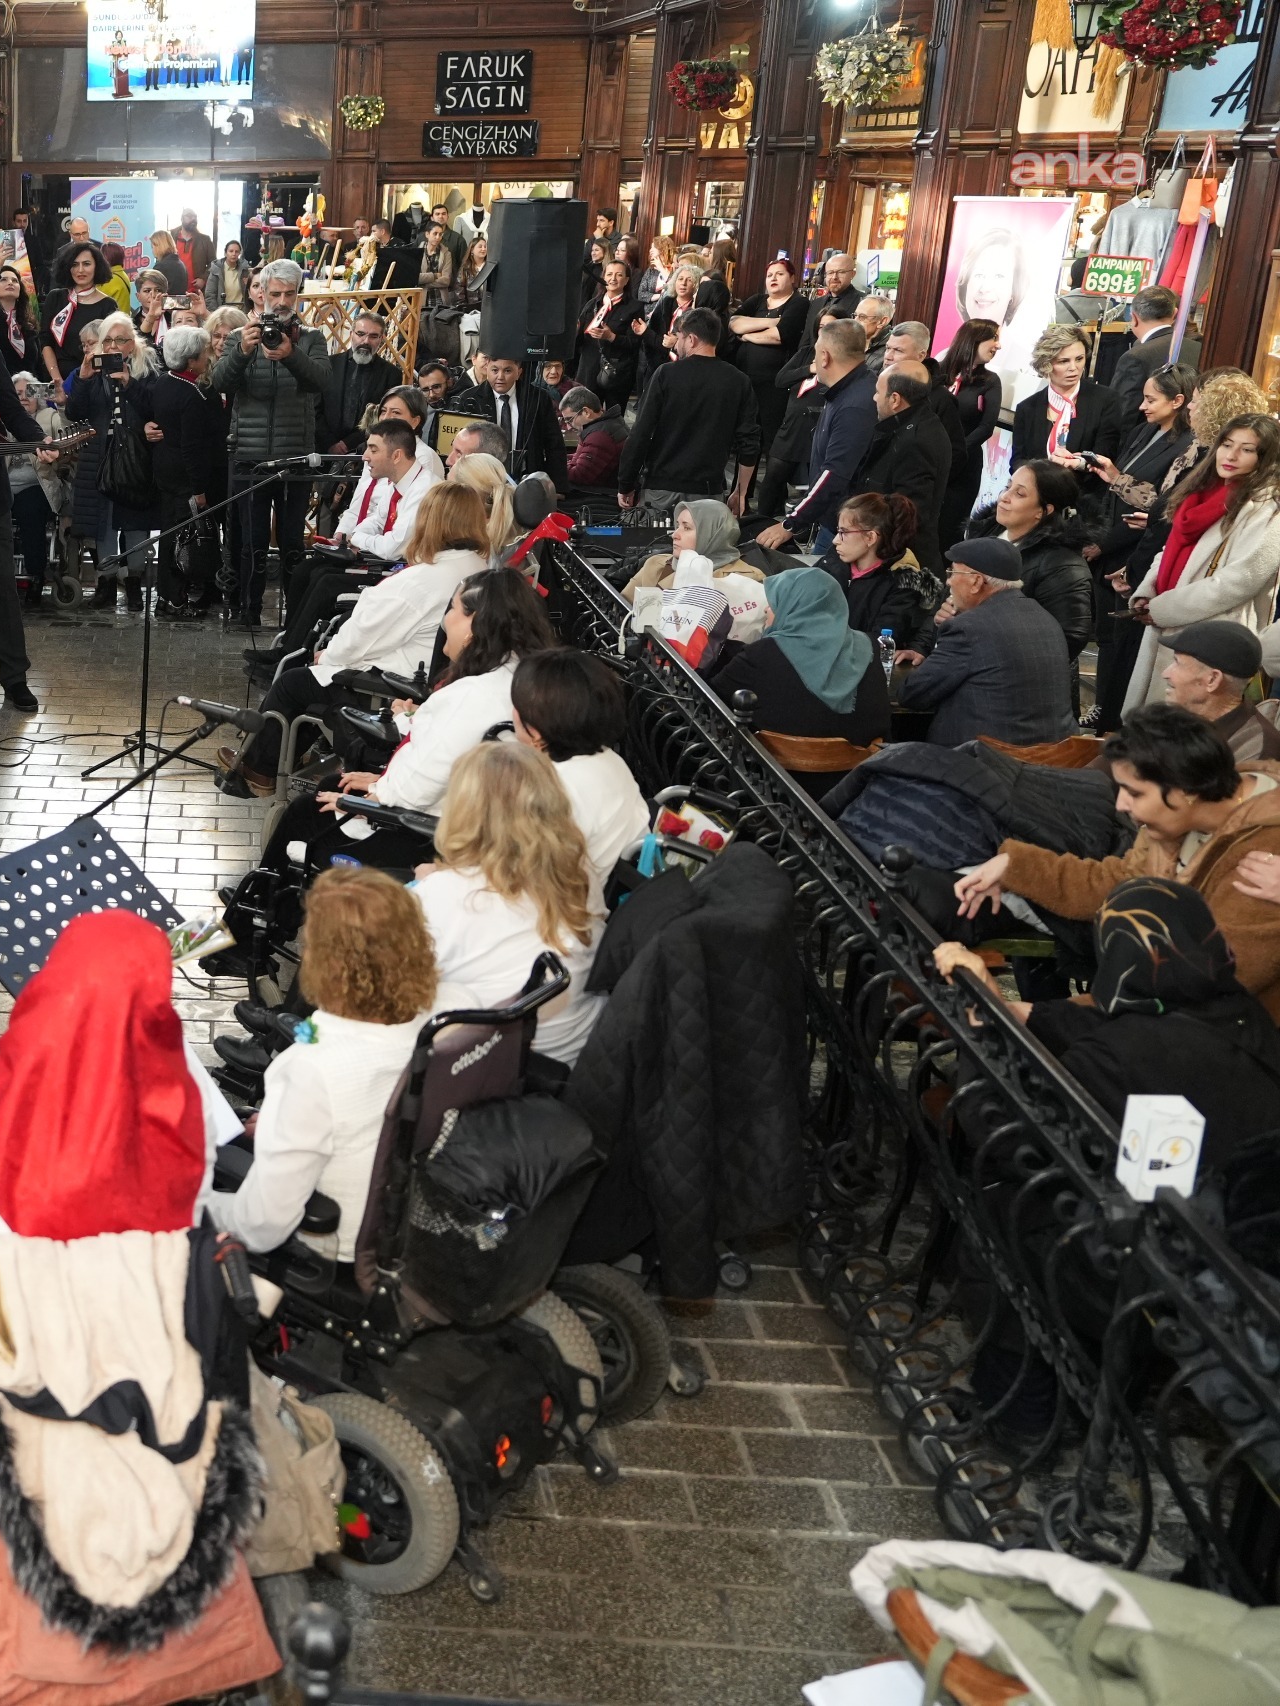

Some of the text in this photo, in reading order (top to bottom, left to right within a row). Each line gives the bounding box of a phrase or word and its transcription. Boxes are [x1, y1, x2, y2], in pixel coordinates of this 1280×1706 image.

[446, 55, 525, 79] FARUK
[429, 123, 533, 140] CENGİZHAN
[1088, 258, 1142, 272] KAMPANYA
[442, 425, 458, 434] SELF
[731, 600, 758, 615] Es Es
